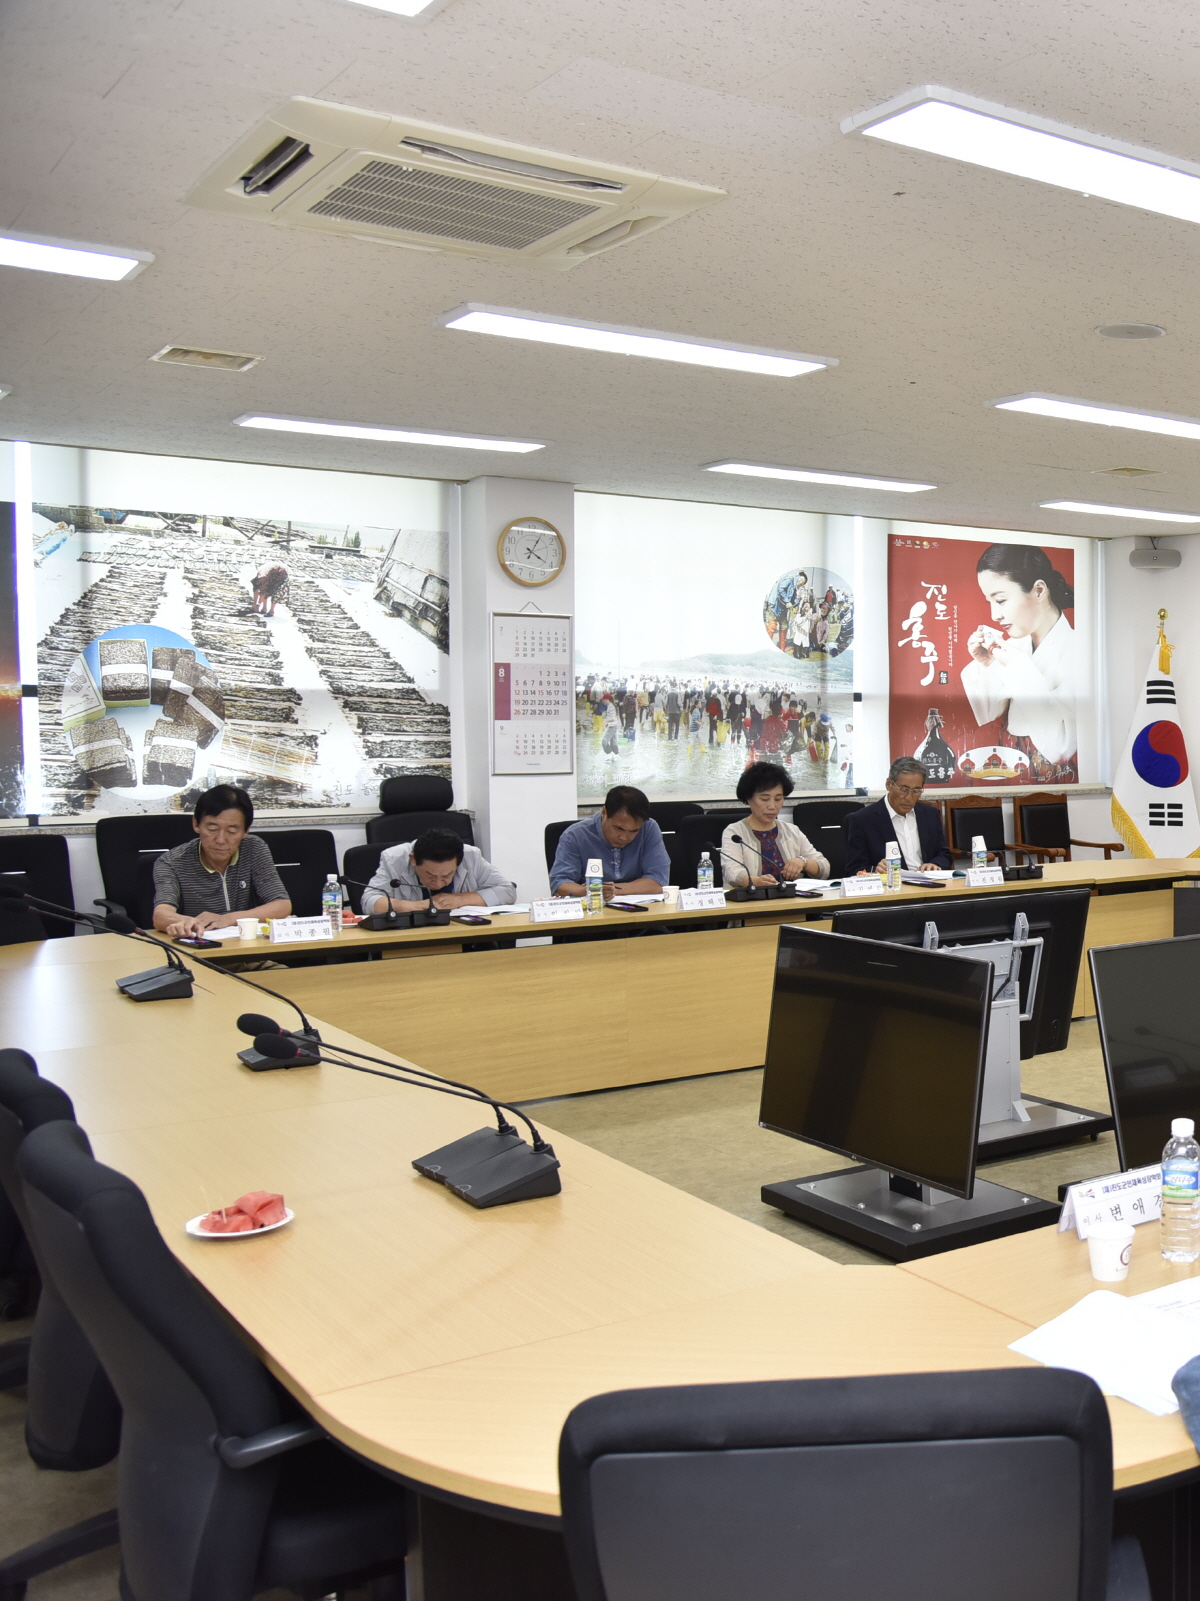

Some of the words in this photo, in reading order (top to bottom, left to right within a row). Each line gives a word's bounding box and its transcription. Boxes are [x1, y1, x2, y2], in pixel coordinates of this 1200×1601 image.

[920, 581, 951, 620] 진도
[898, 601, 939, 686] 홍주
[499, 668, 505, 677] 8
[928, 767, 955, 779] 도홍주
